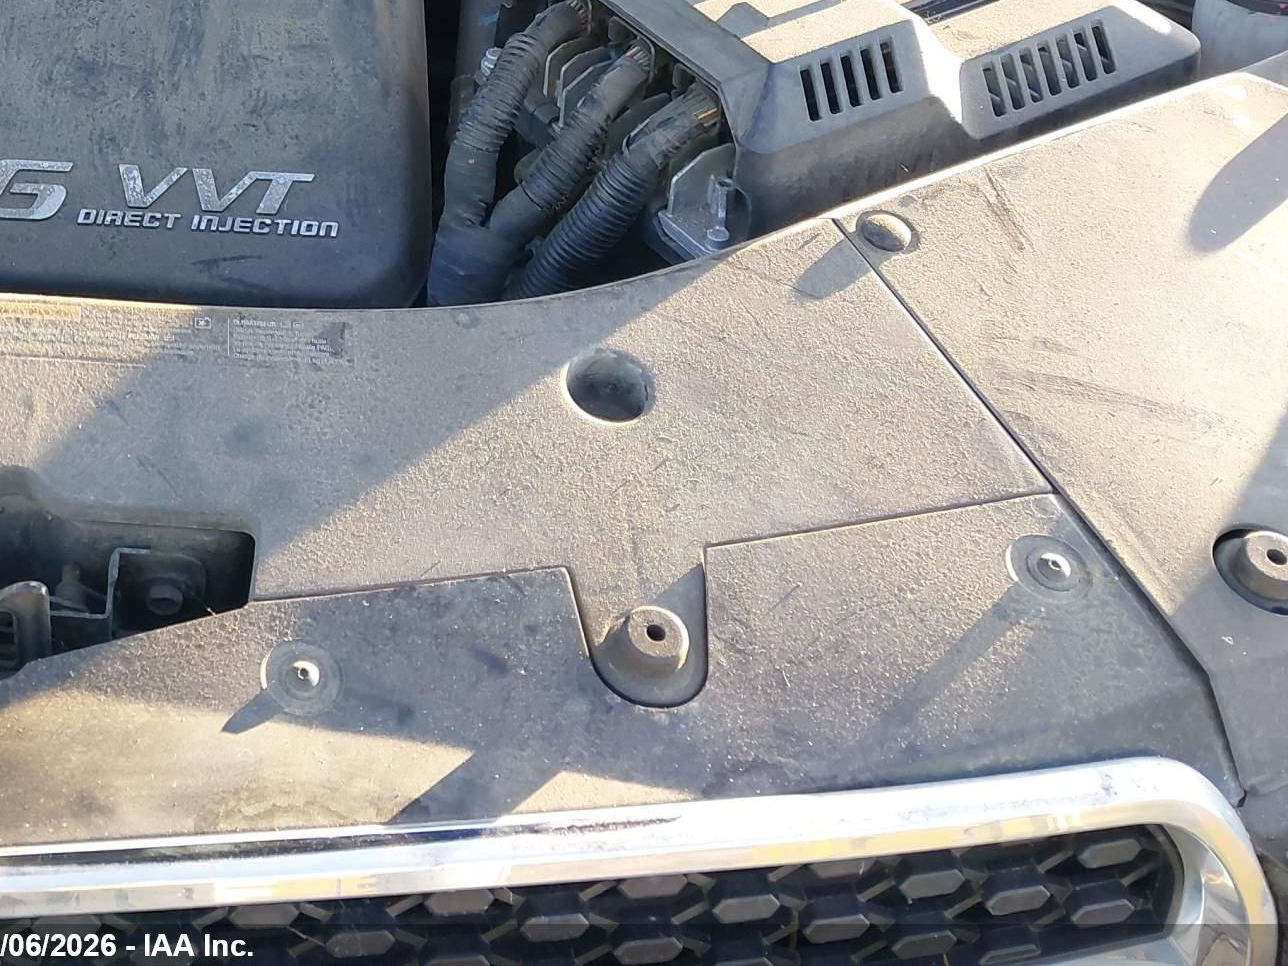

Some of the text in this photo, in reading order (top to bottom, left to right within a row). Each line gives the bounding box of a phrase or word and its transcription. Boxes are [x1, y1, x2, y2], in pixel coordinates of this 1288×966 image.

[118, 163, 316, 215] VVT
[77, 208, 340, 238] DIRECT INJECTION
